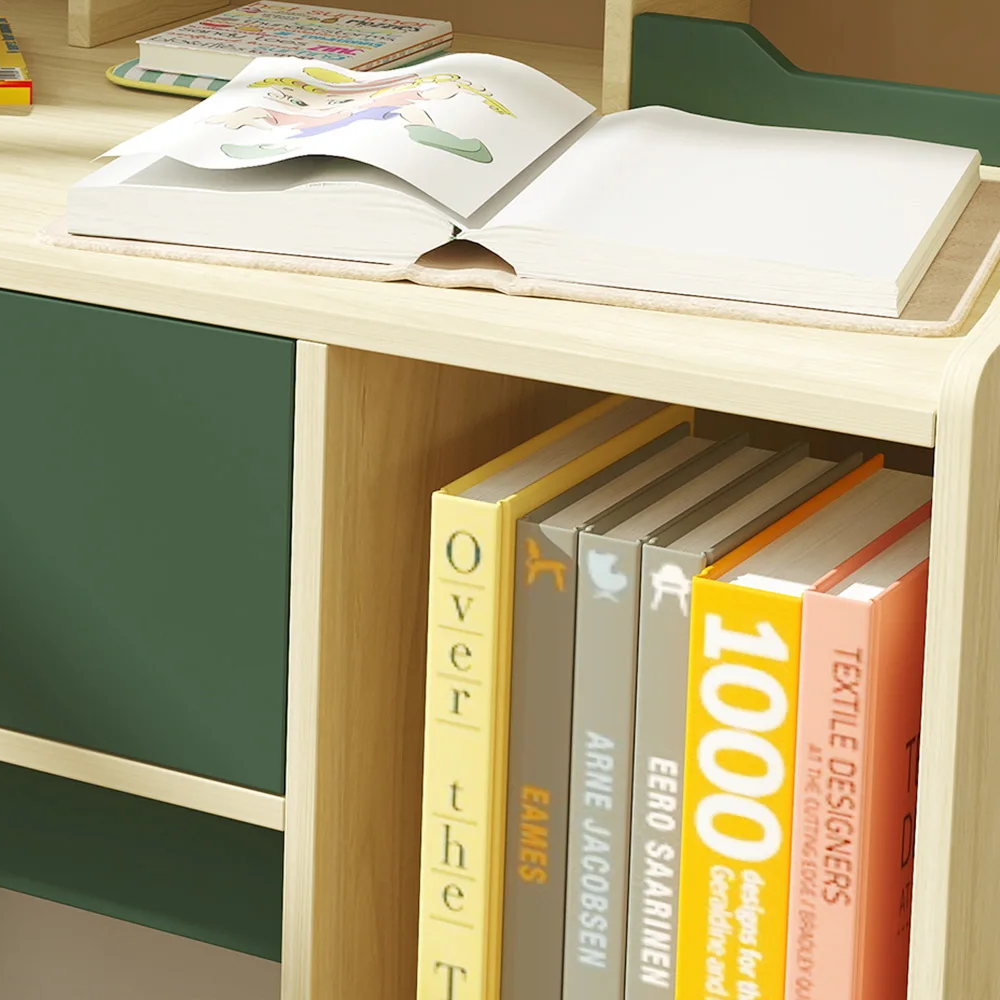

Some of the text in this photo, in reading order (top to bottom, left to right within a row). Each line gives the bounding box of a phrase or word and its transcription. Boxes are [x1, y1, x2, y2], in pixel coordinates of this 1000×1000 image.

[694, 613, 789, 863] 1000
[822, 648, 862, 905] TEXTILE DESIGNERS
[518, 784, 550, 884] EAMES
[578, 729, 614, 969] ARNE JACOBSEN
[639, 756, 679, 989] EERO SAARINEN
[706, 864, 735, 956] Geraldine
[735, 869, 765, 946] designs
[705, 957, 729, 997] and
[737, 947, 763, 979] for
